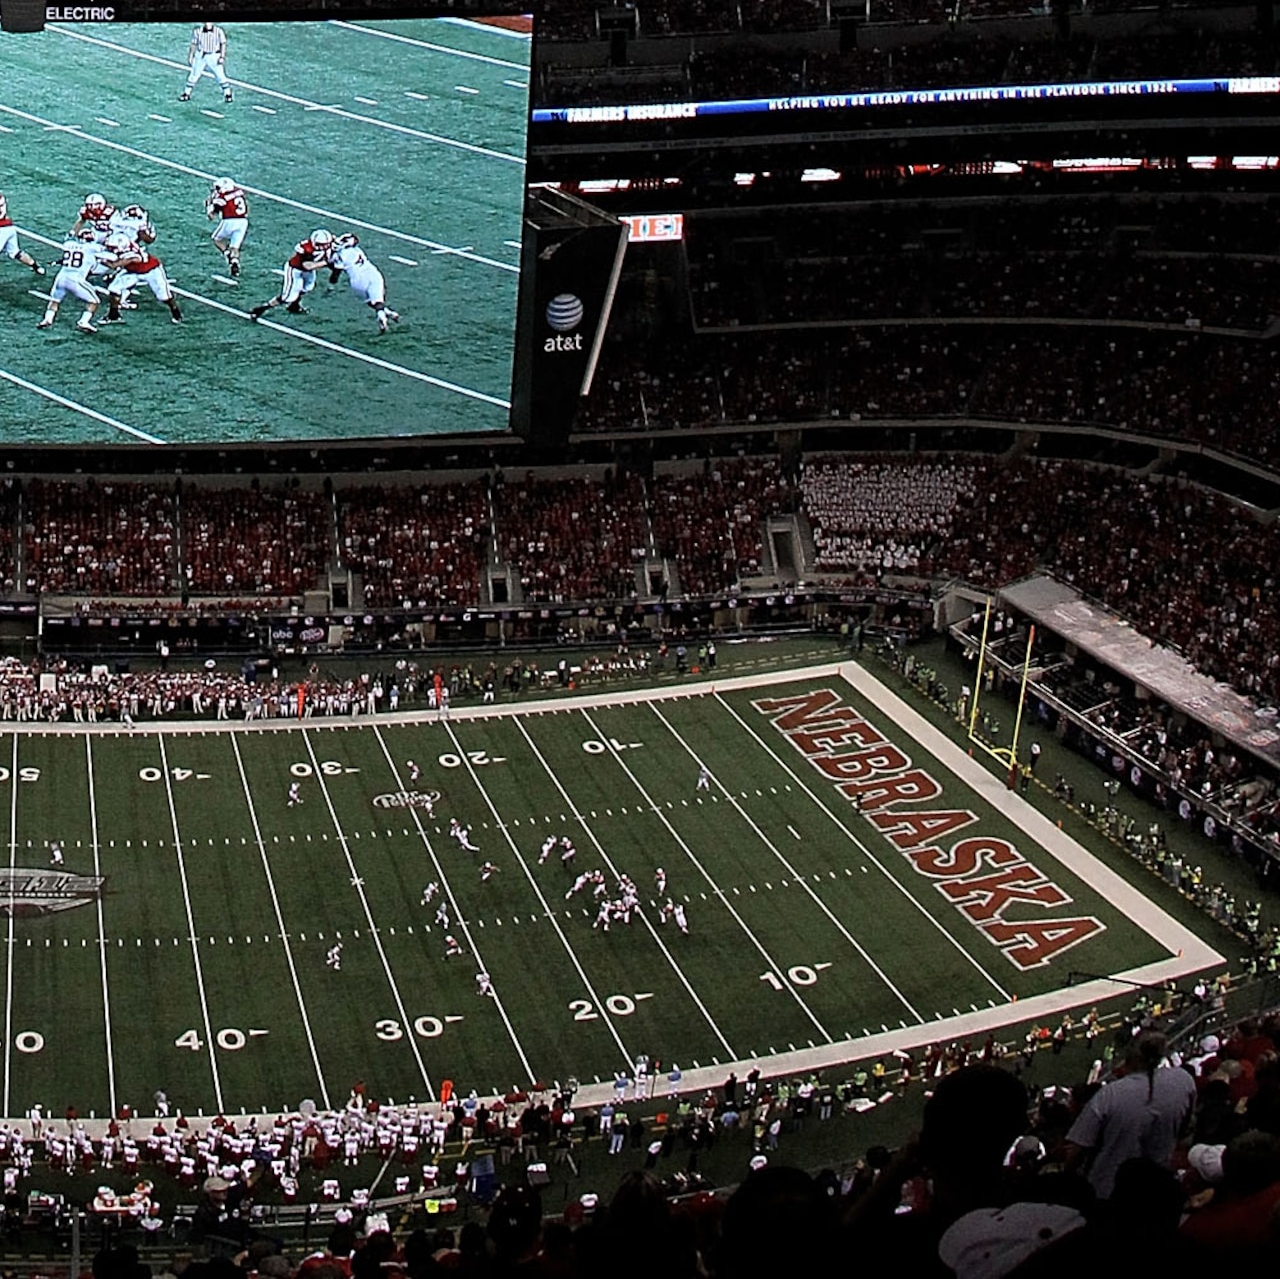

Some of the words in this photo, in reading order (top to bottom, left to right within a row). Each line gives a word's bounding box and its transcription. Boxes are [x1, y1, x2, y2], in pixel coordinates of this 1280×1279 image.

[46, 6, 115, 20] ELECTRIC
[823, 95, 846, 108] YOU
[851, 94, 865, 106] BE
[939, 88, 999, 102] ANYTHING
[1003, 87, 1016, 98] IN
[1046, 83, 1105, 96] PLAYBOOK
[1108, 81, 1142, 94] SINCE
[567, 106, 625, 123] FARMERS
[627, 103, 698, 121] INSURANCE
[63, 250, 84, 268] 28
[543, 333, 583, 352] at&t
[581, 737, 636, 755] 10
[438, 750, 490, 768] 20
[139, 766, 193, 782] 40
[289, 761, 343, 777] 30
[750, 688, 1107, 971] NEBRASKA
[759, 964, 818, 992] 10
[568, 994, 636, 1022] 20
[374, 1016, 444, 1041] 30
[174, 1028, 247, 1051] 40
